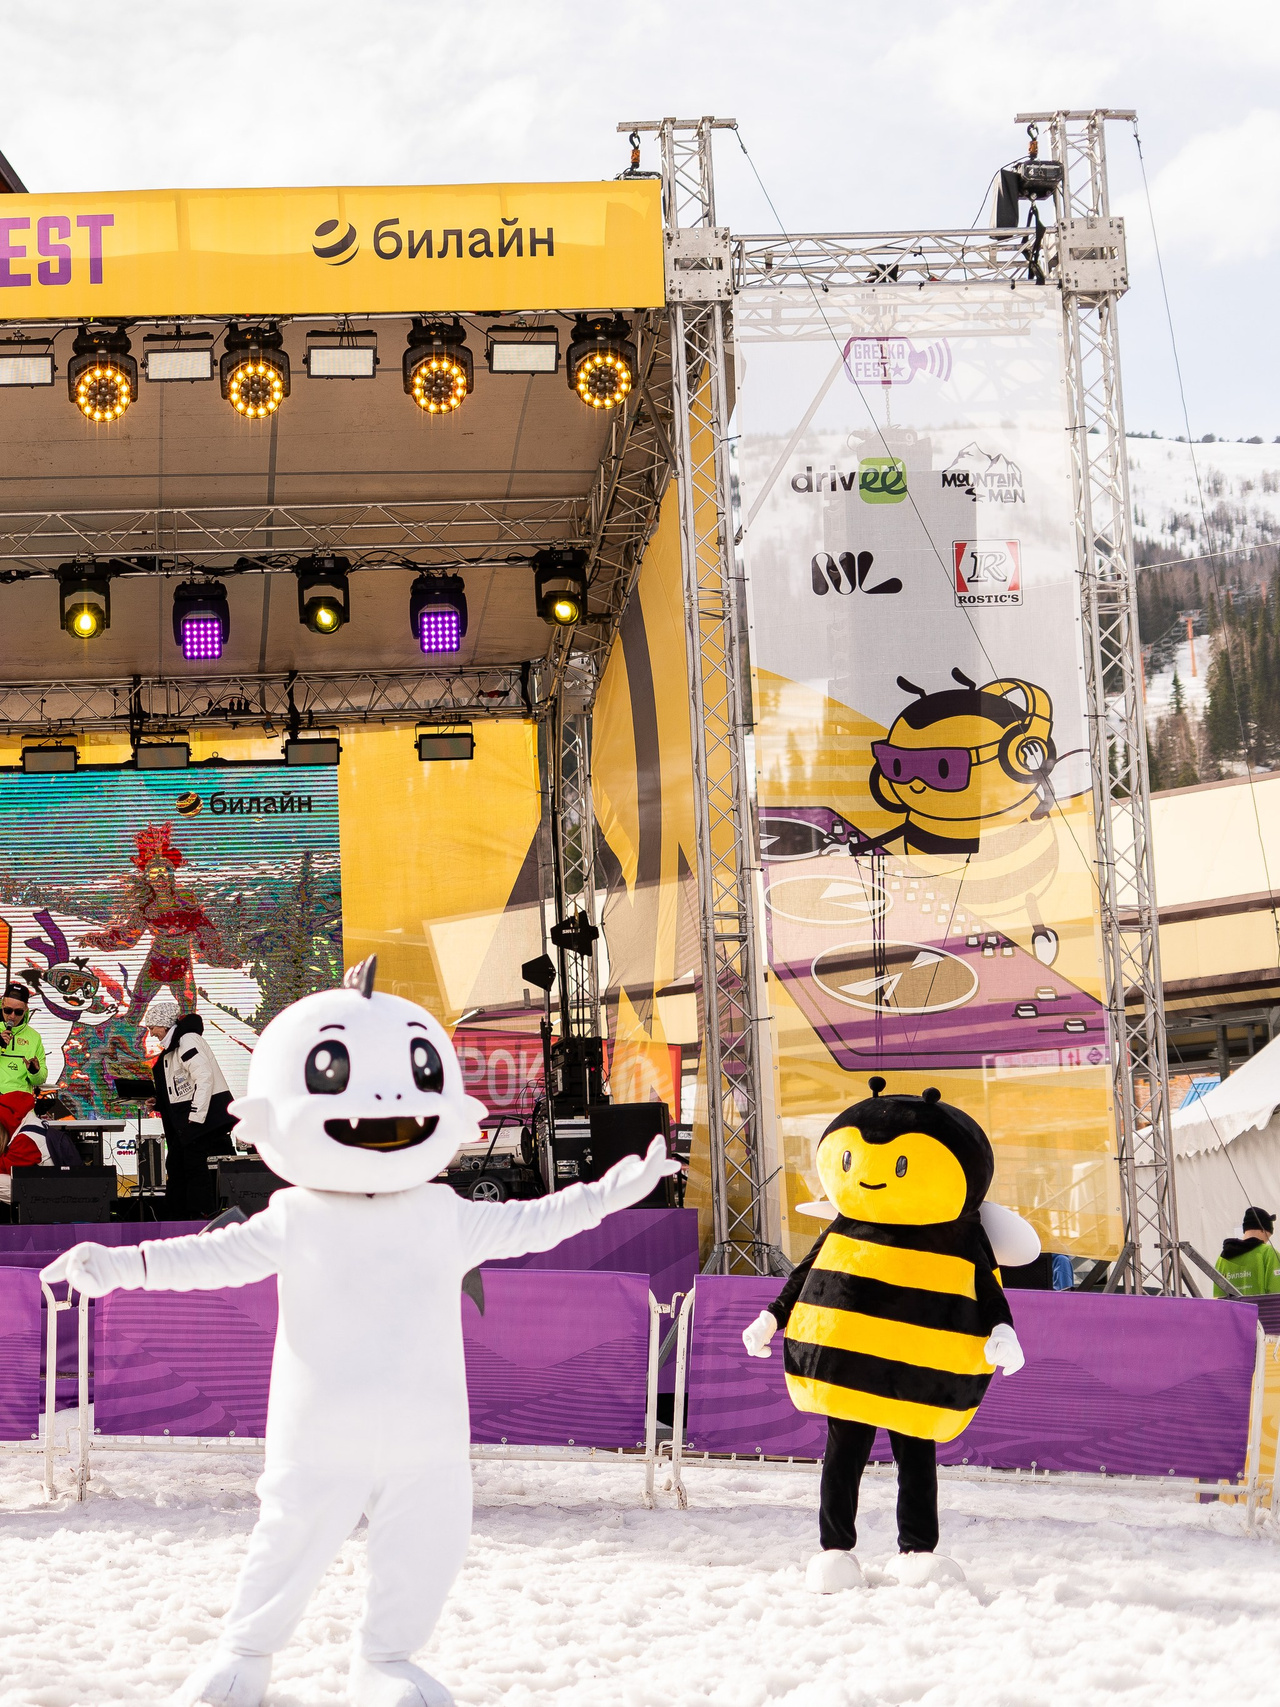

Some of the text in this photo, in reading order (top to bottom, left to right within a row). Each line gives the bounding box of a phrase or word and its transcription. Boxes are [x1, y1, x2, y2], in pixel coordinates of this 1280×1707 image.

[373, 217, 556, 261] билайн
[854, 342, 905, 361] GRELKA
[855, 362, 890, 379] FEST
[941, 472, 1023, 488] MOUNTAIN
[988, 488, 1026, 503] MAN
[957, 594, 1020, 604] ROSTIC'S
[209, 790, 313, 816] билайн
